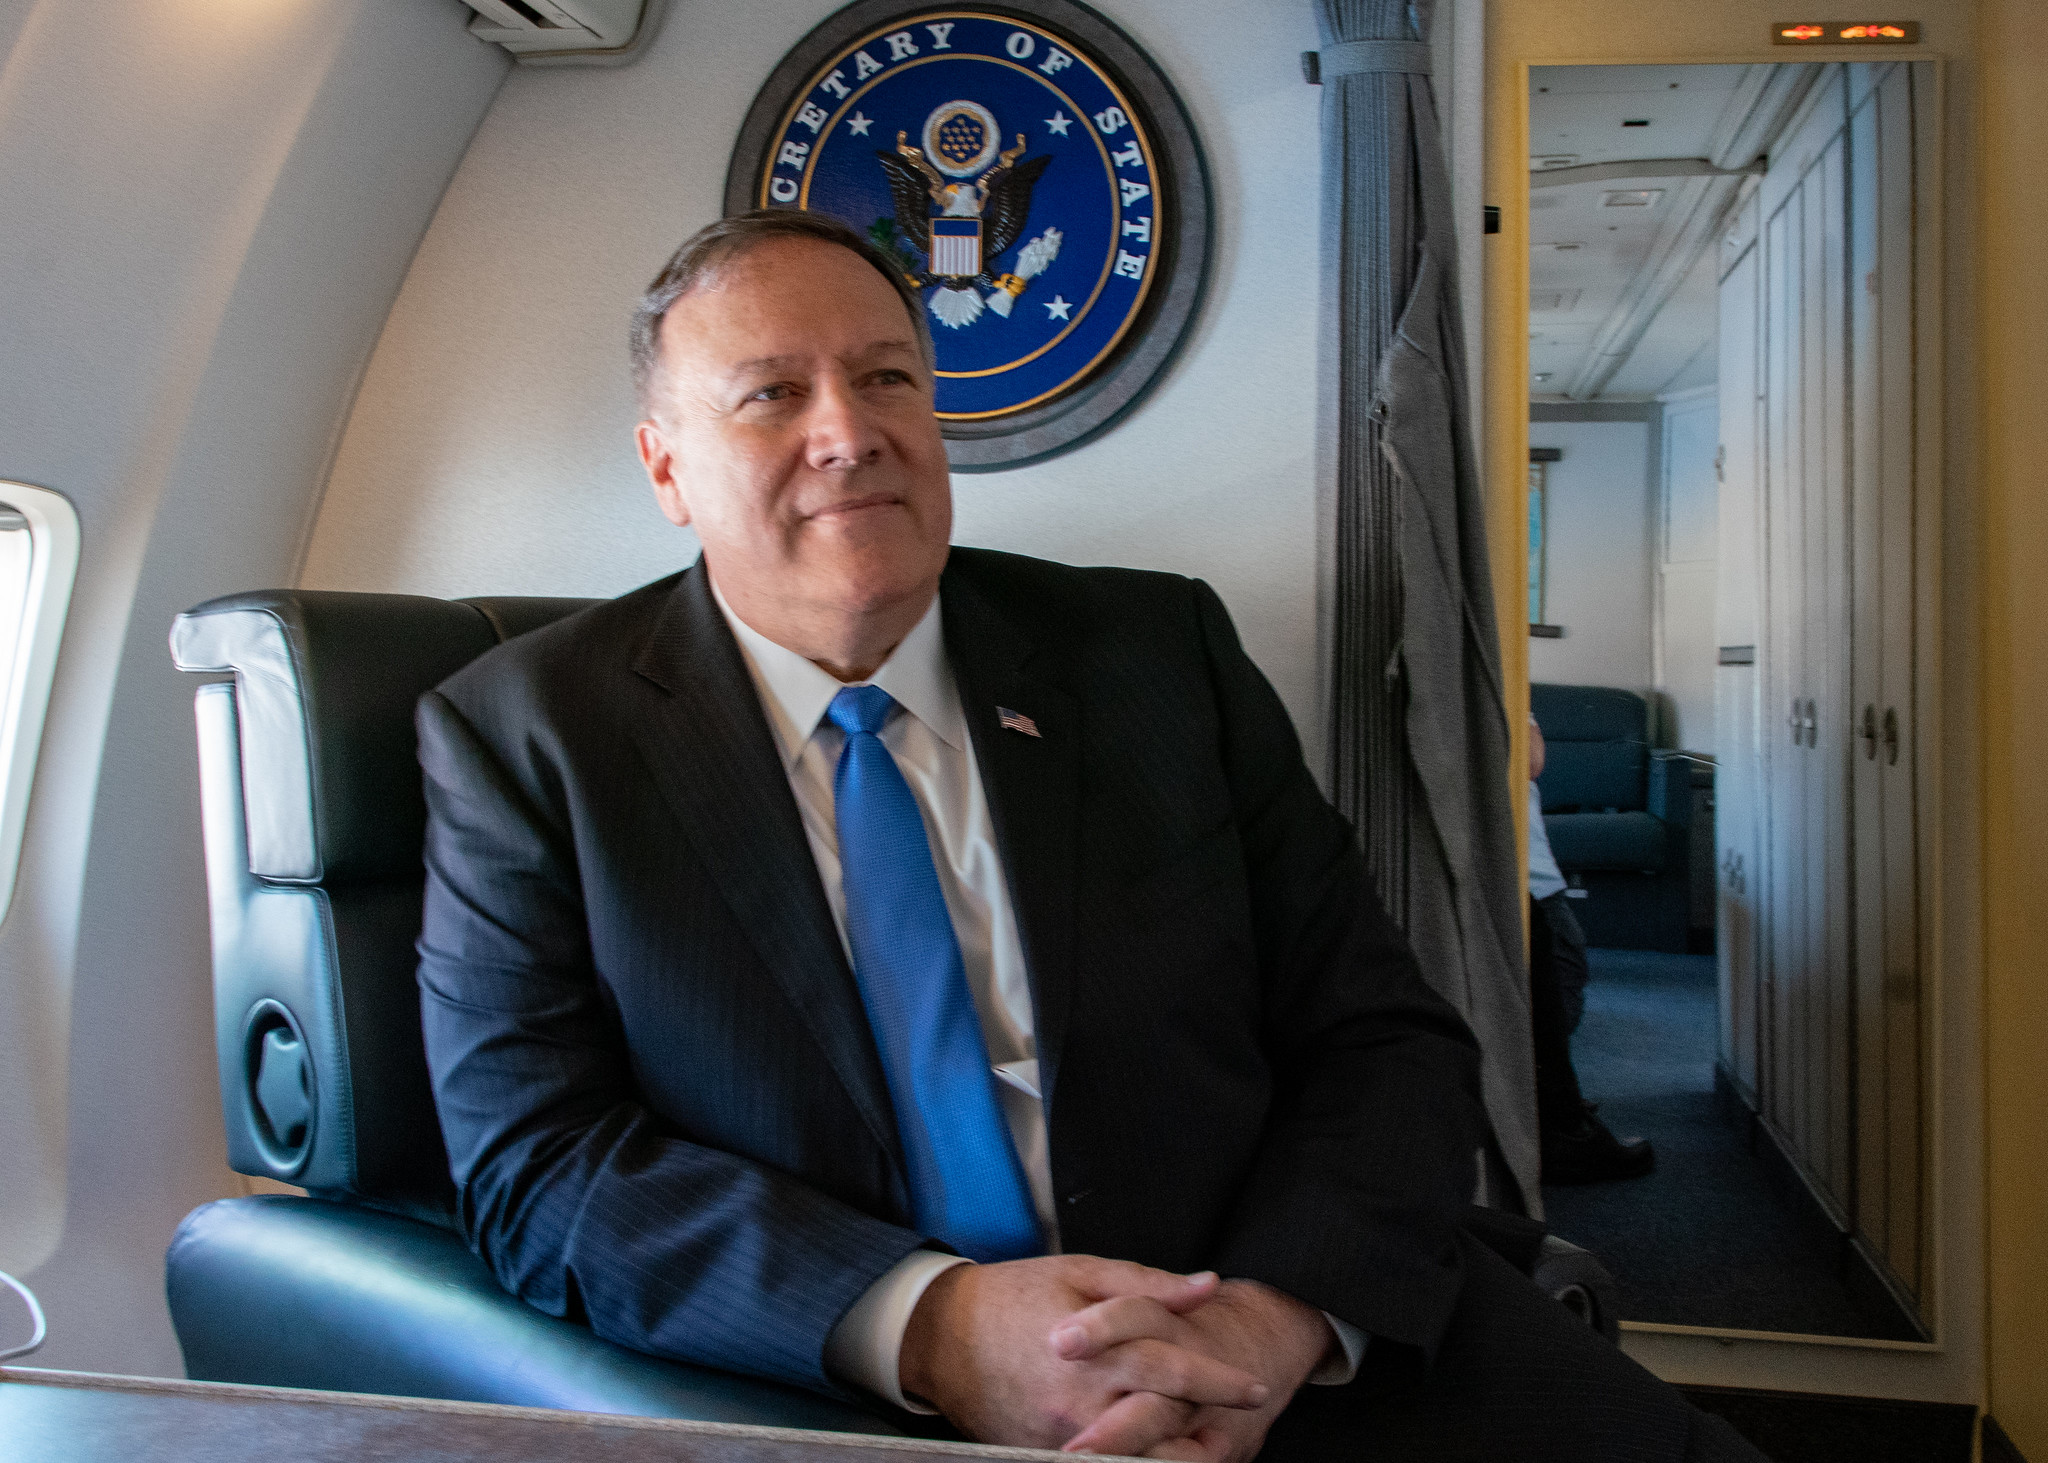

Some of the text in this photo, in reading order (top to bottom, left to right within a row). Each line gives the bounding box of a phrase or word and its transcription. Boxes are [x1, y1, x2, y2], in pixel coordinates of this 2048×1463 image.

[770, 22, 1151, 280] CRETARY OF STATE
